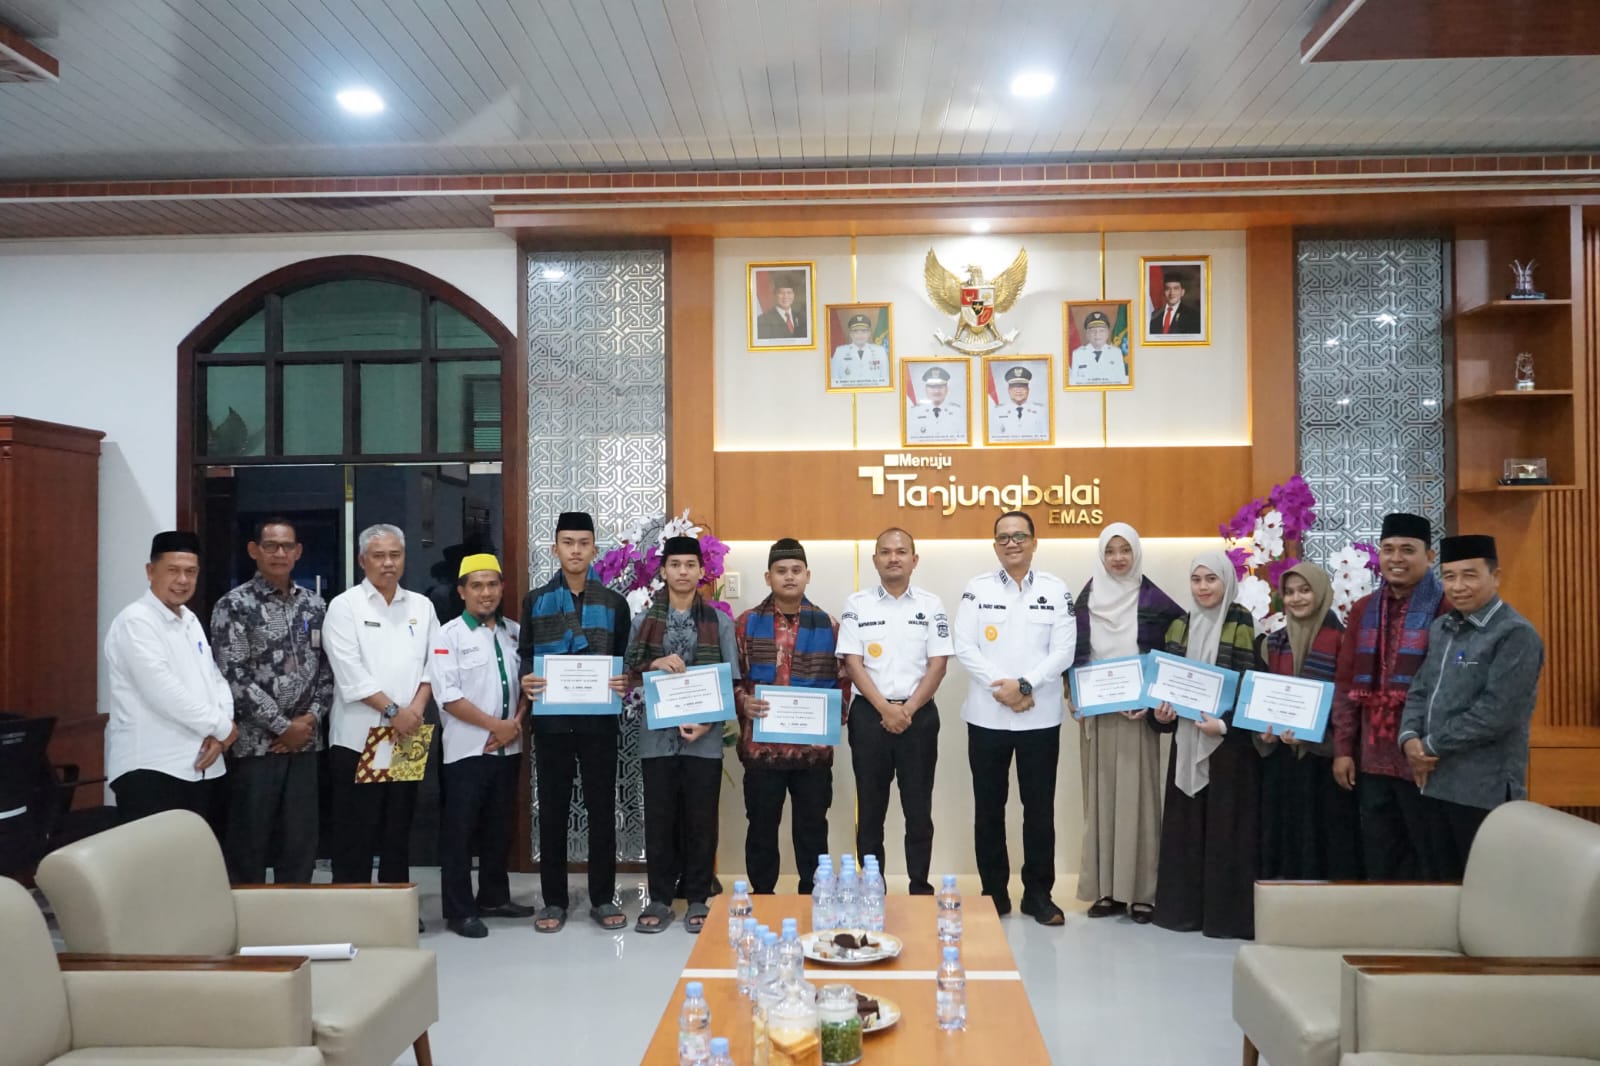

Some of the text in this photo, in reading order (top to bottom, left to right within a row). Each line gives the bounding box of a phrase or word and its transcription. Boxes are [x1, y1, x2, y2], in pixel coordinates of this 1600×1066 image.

[900, 453, 952, 469] Menuju
[885, 474, 1100, 515] Tanjungbalai
[1049, 508, 1104, 524] EMAS
